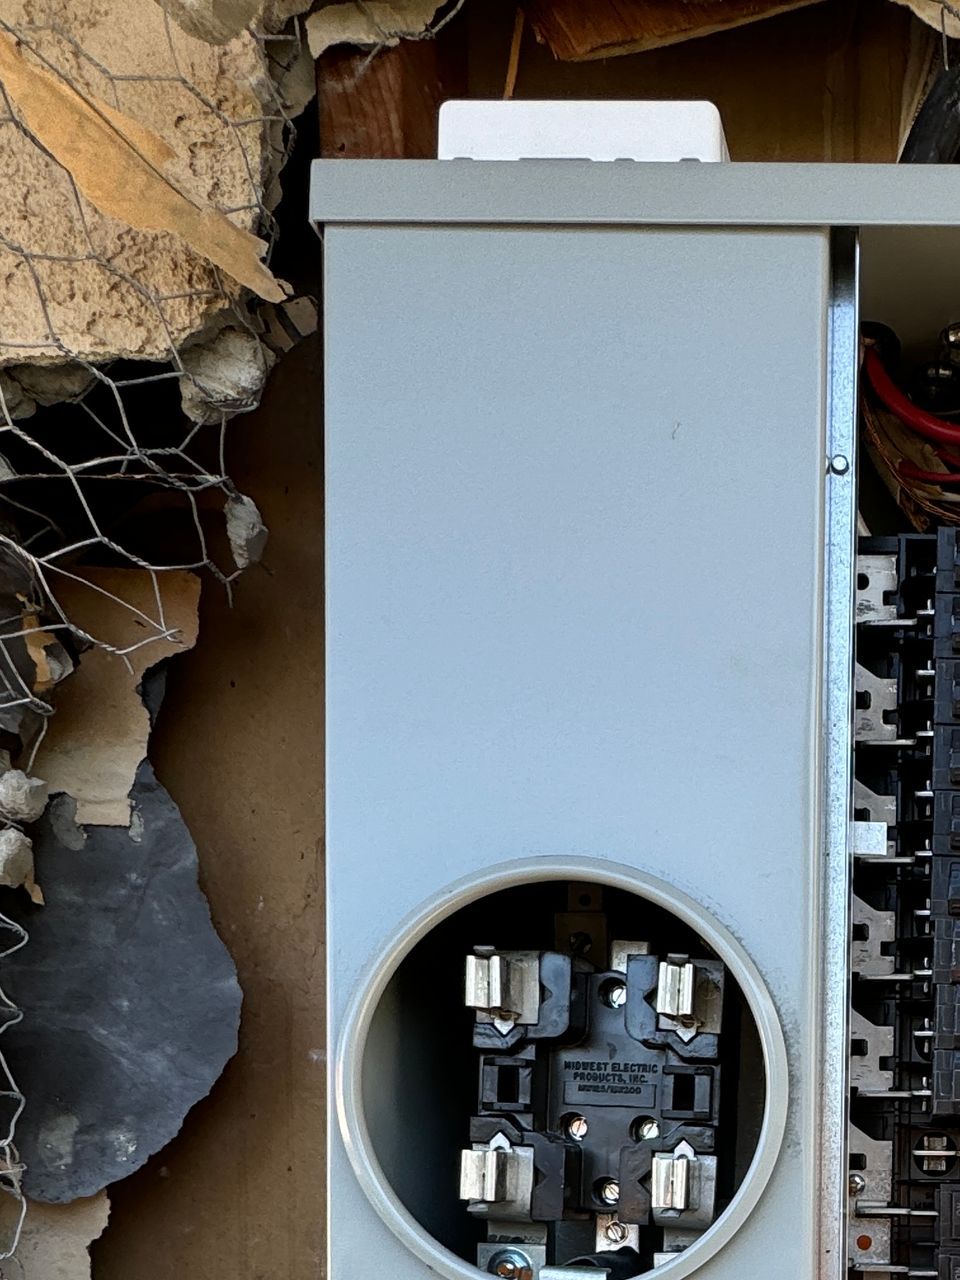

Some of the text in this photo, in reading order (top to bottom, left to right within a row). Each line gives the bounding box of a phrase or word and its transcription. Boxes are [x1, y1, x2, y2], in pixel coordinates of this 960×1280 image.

[564, 1061, 658, 1073] MIDWEST ELECTRIC
[630, 1074, 648, 1083] INC.
